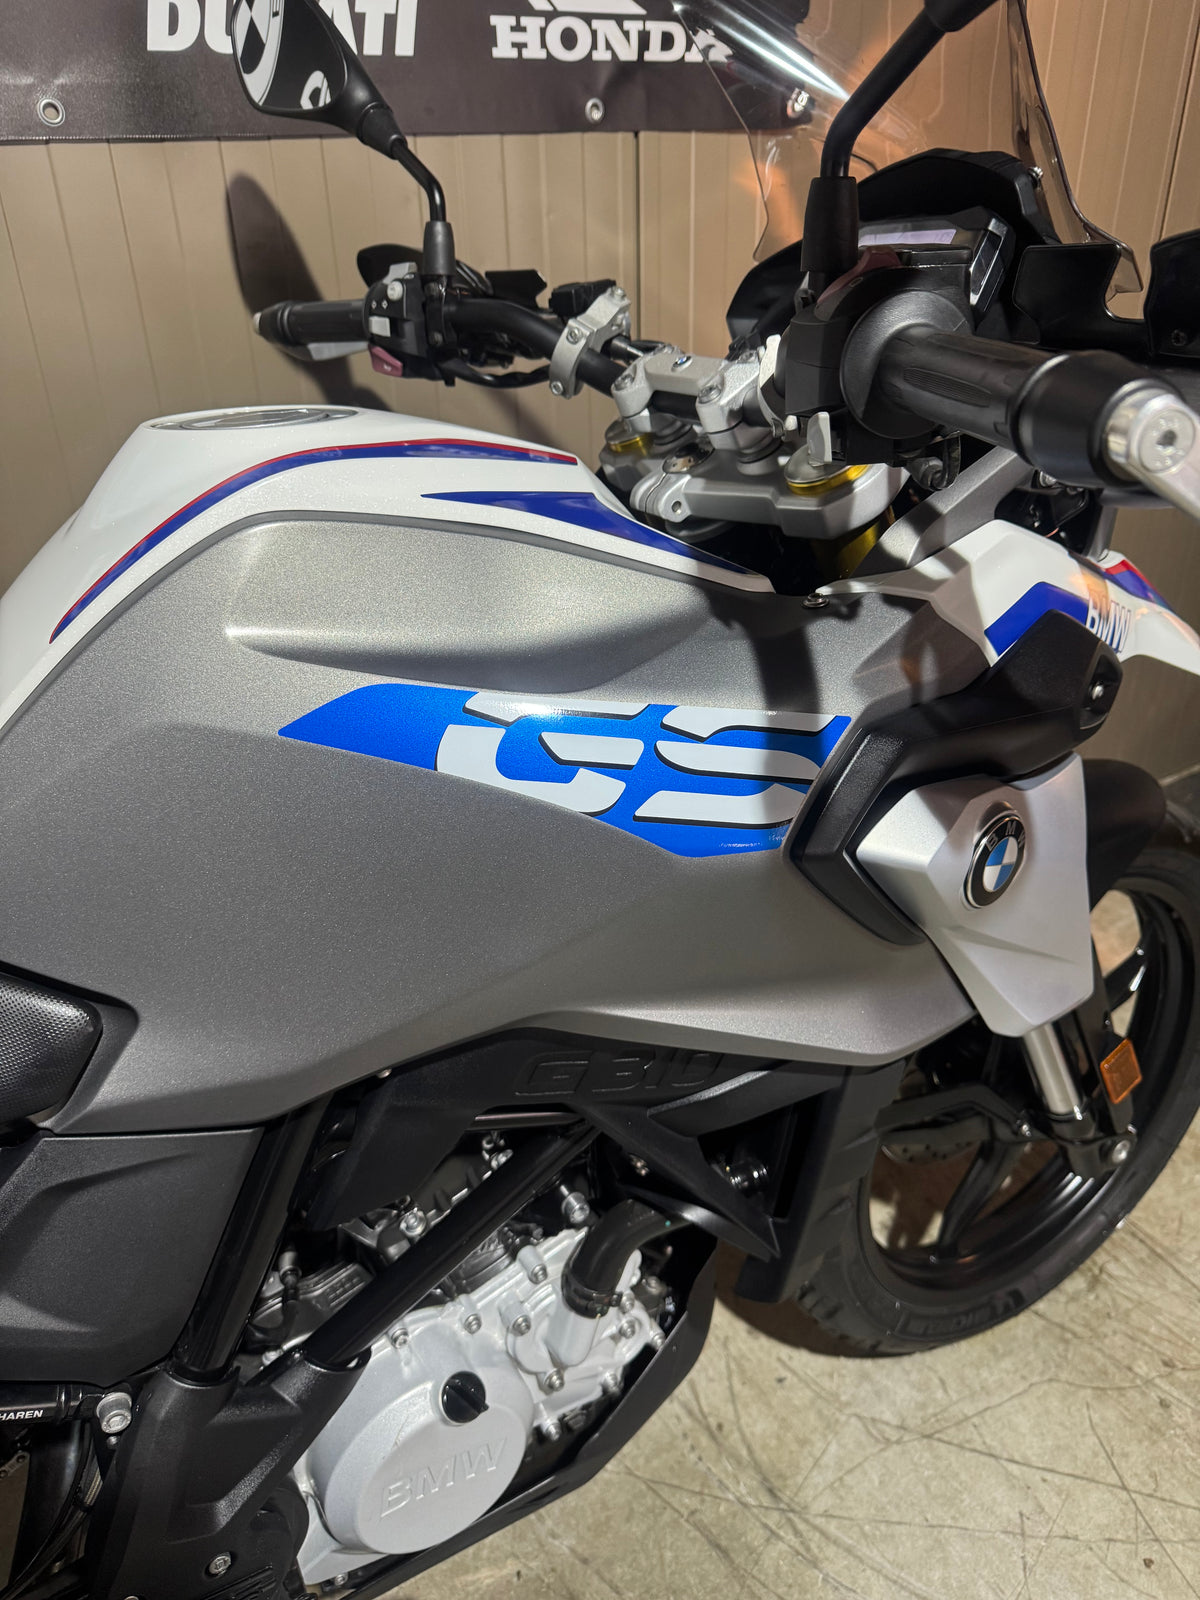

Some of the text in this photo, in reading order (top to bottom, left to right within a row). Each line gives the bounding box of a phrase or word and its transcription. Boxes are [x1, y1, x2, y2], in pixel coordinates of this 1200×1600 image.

[490, 15, 733, 63] HONDA
[1086, 597, 1131, 654] BMW
[435, 691, 837, 829] GS
[985, 820, 1025, 851] BMW
[378, 1437, 507, 1518] BMW
